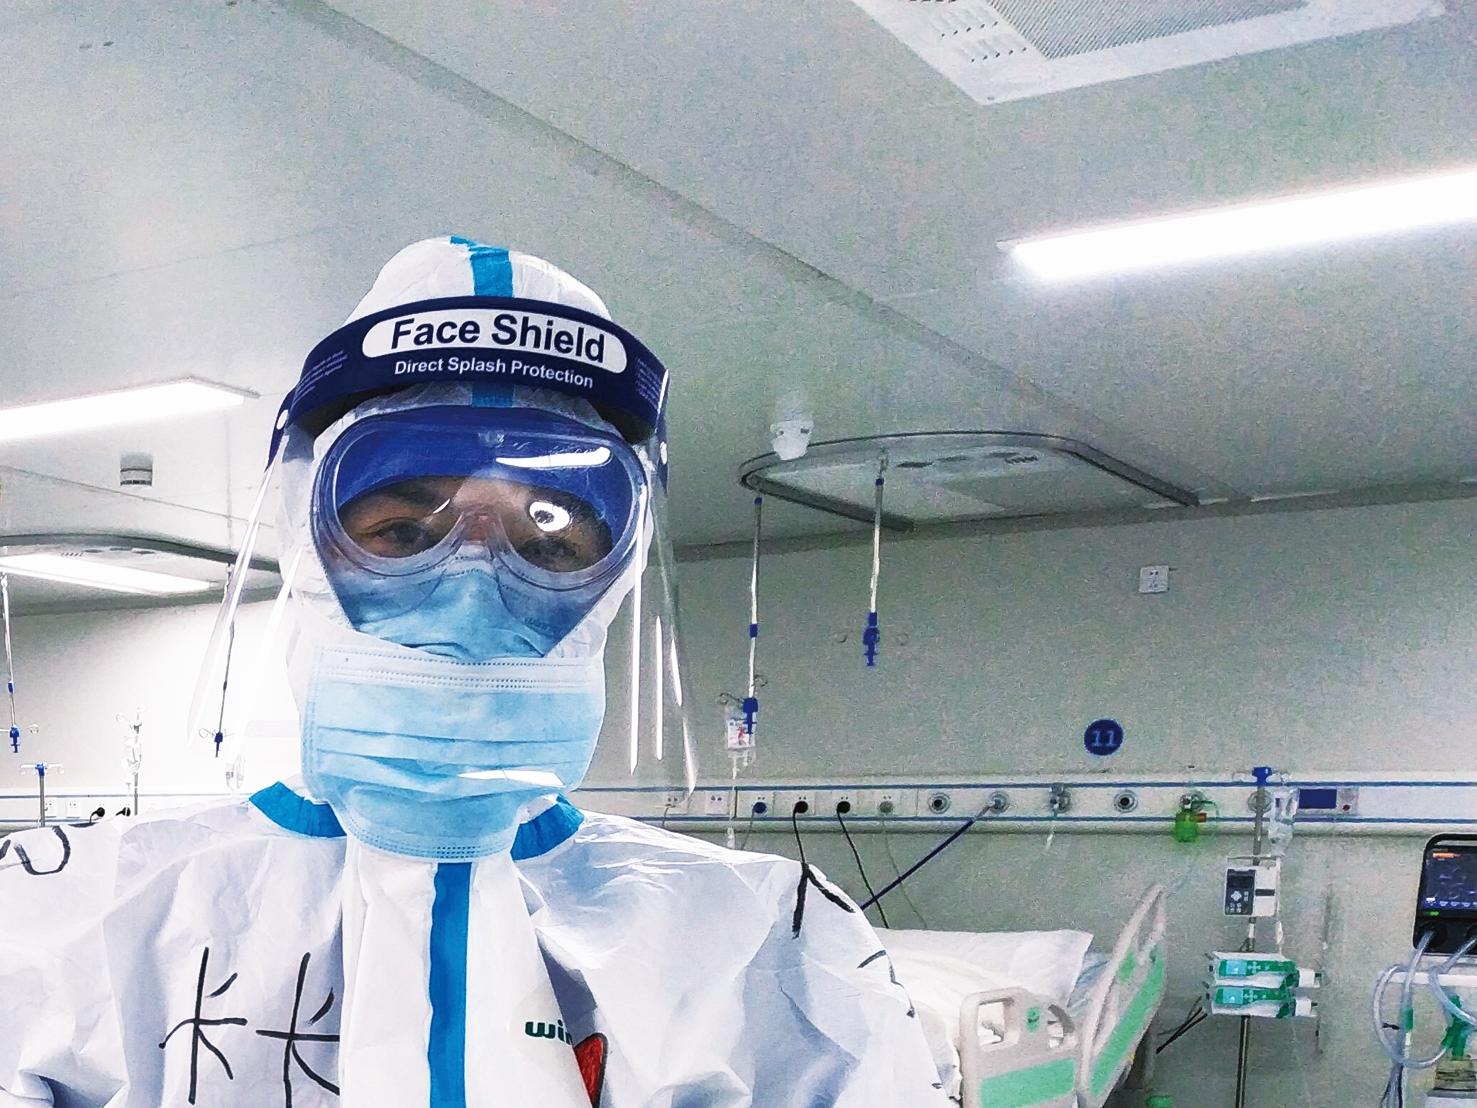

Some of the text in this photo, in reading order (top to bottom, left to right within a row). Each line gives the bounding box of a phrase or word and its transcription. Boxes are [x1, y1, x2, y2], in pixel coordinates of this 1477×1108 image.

[391, 313, 605, 364] Face Shield
[394, 357, 593, 389] Direct Splash Protection
[1091, 729, 1117, 747] 11
